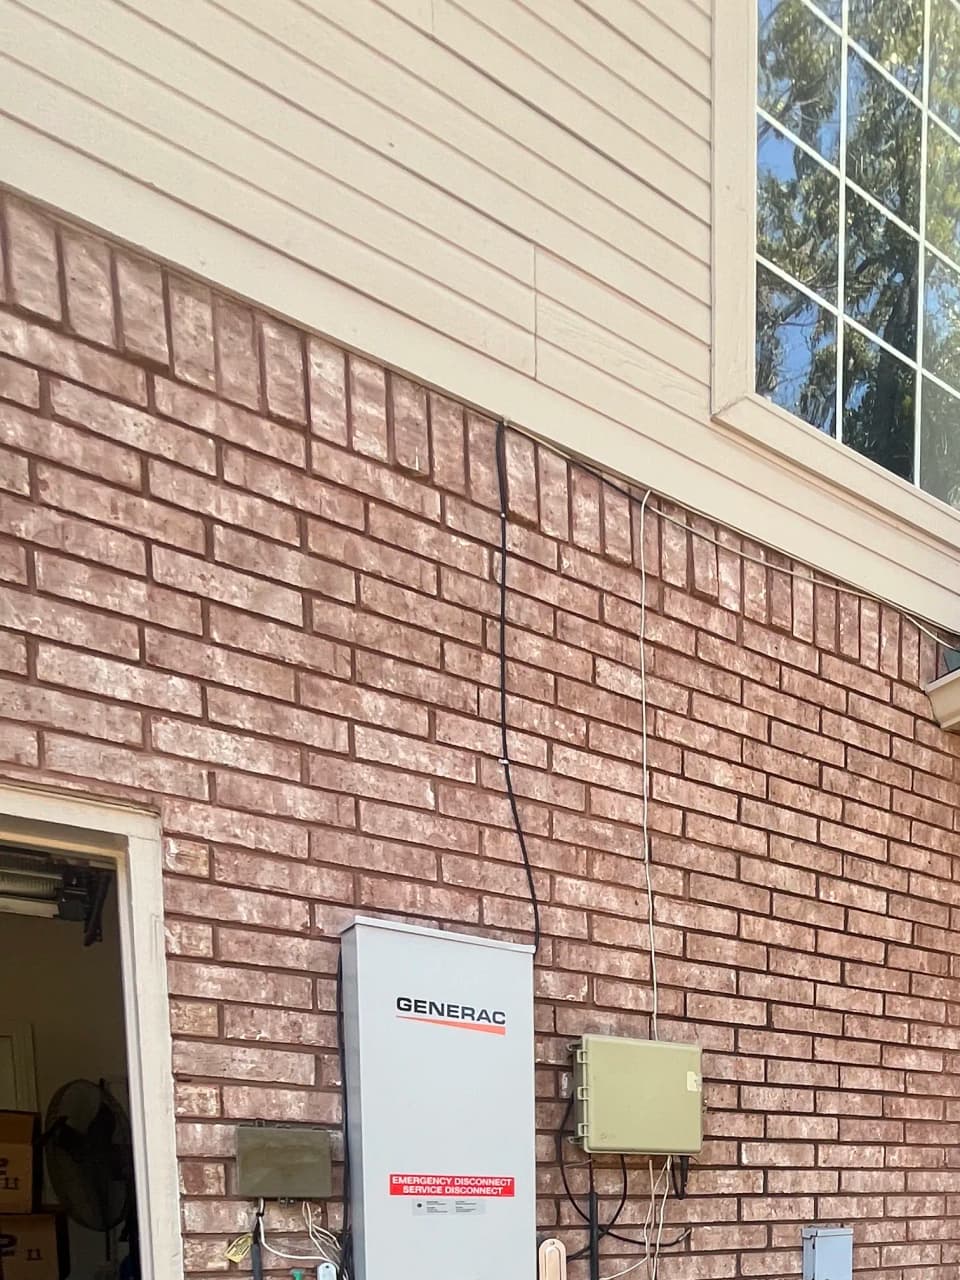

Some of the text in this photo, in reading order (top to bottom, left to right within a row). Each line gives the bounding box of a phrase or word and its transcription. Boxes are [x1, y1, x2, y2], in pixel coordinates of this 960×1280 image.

[397, 997, 506, 1025] GENERAC
[392, 1176, 513, 1187] EMERGENCY DISCONNECT
[403, 1185, 503, 1196] SERVICE DISCONNECT
